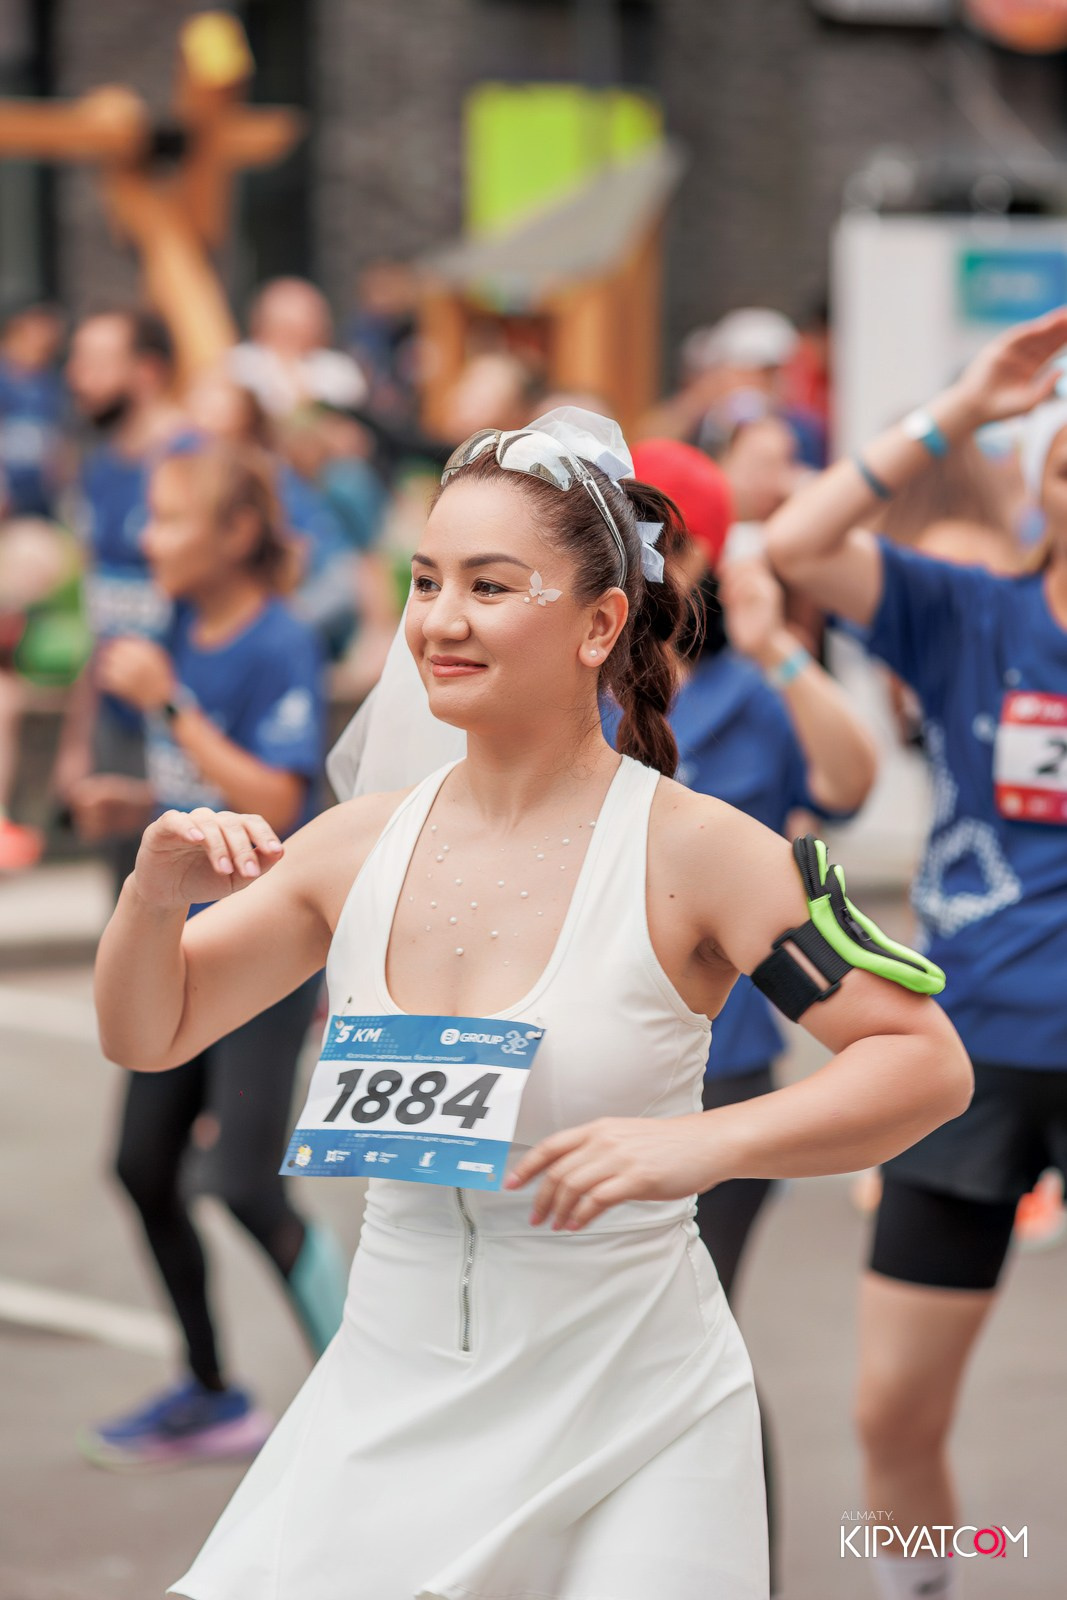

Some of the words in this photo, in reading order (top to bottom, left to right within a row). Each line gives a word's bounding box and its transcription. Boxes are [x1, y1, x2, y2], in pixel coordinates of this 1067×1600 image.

[335, 1025, 354, 1043] 5
[352, 1028, 383, 1043] KM
[460, 1032, 505, 1045] GROUP
[322, 1068, 502, 1130] 1884
